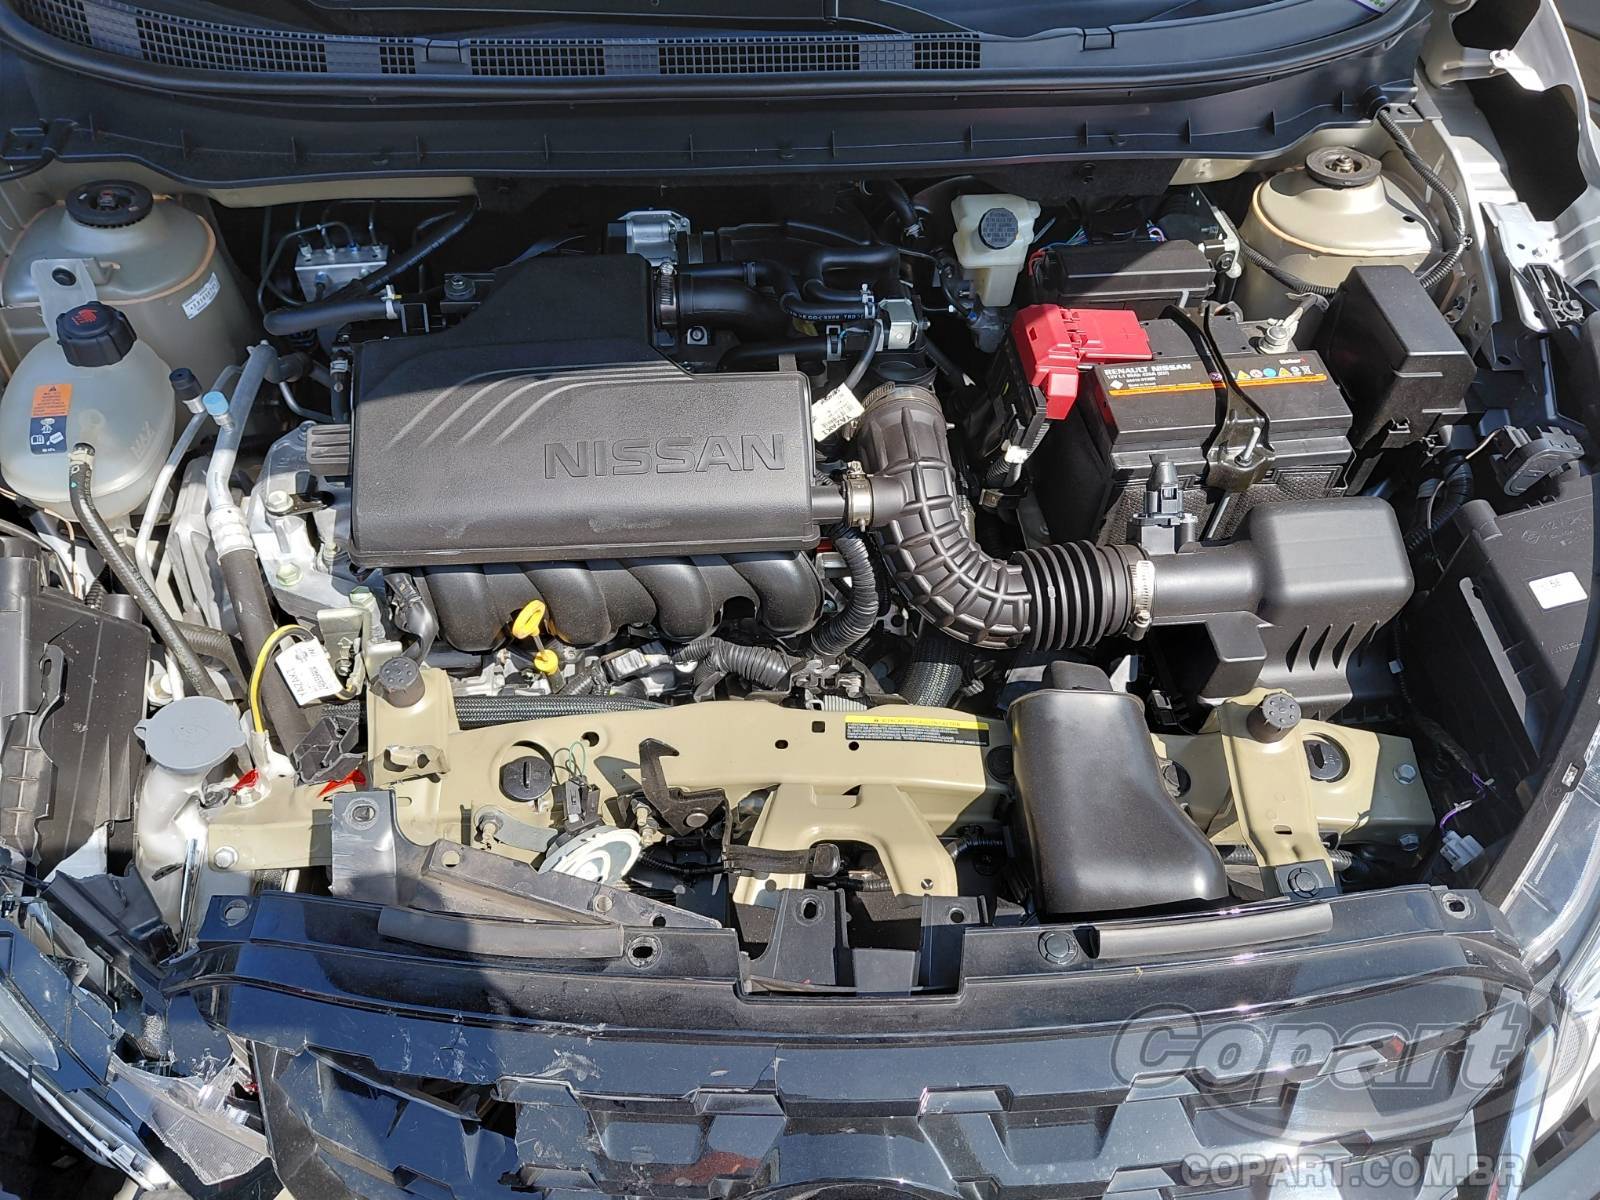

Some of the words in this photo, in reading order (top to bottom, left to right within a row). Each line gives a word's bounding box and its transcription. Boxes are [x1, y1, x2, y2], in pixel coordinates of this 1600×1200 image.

[1104, 366, 1148, 376] RENAULT
[1151, 363, 1192, 372] NISSAN
[544, 433, 785, 480] NISSAN
